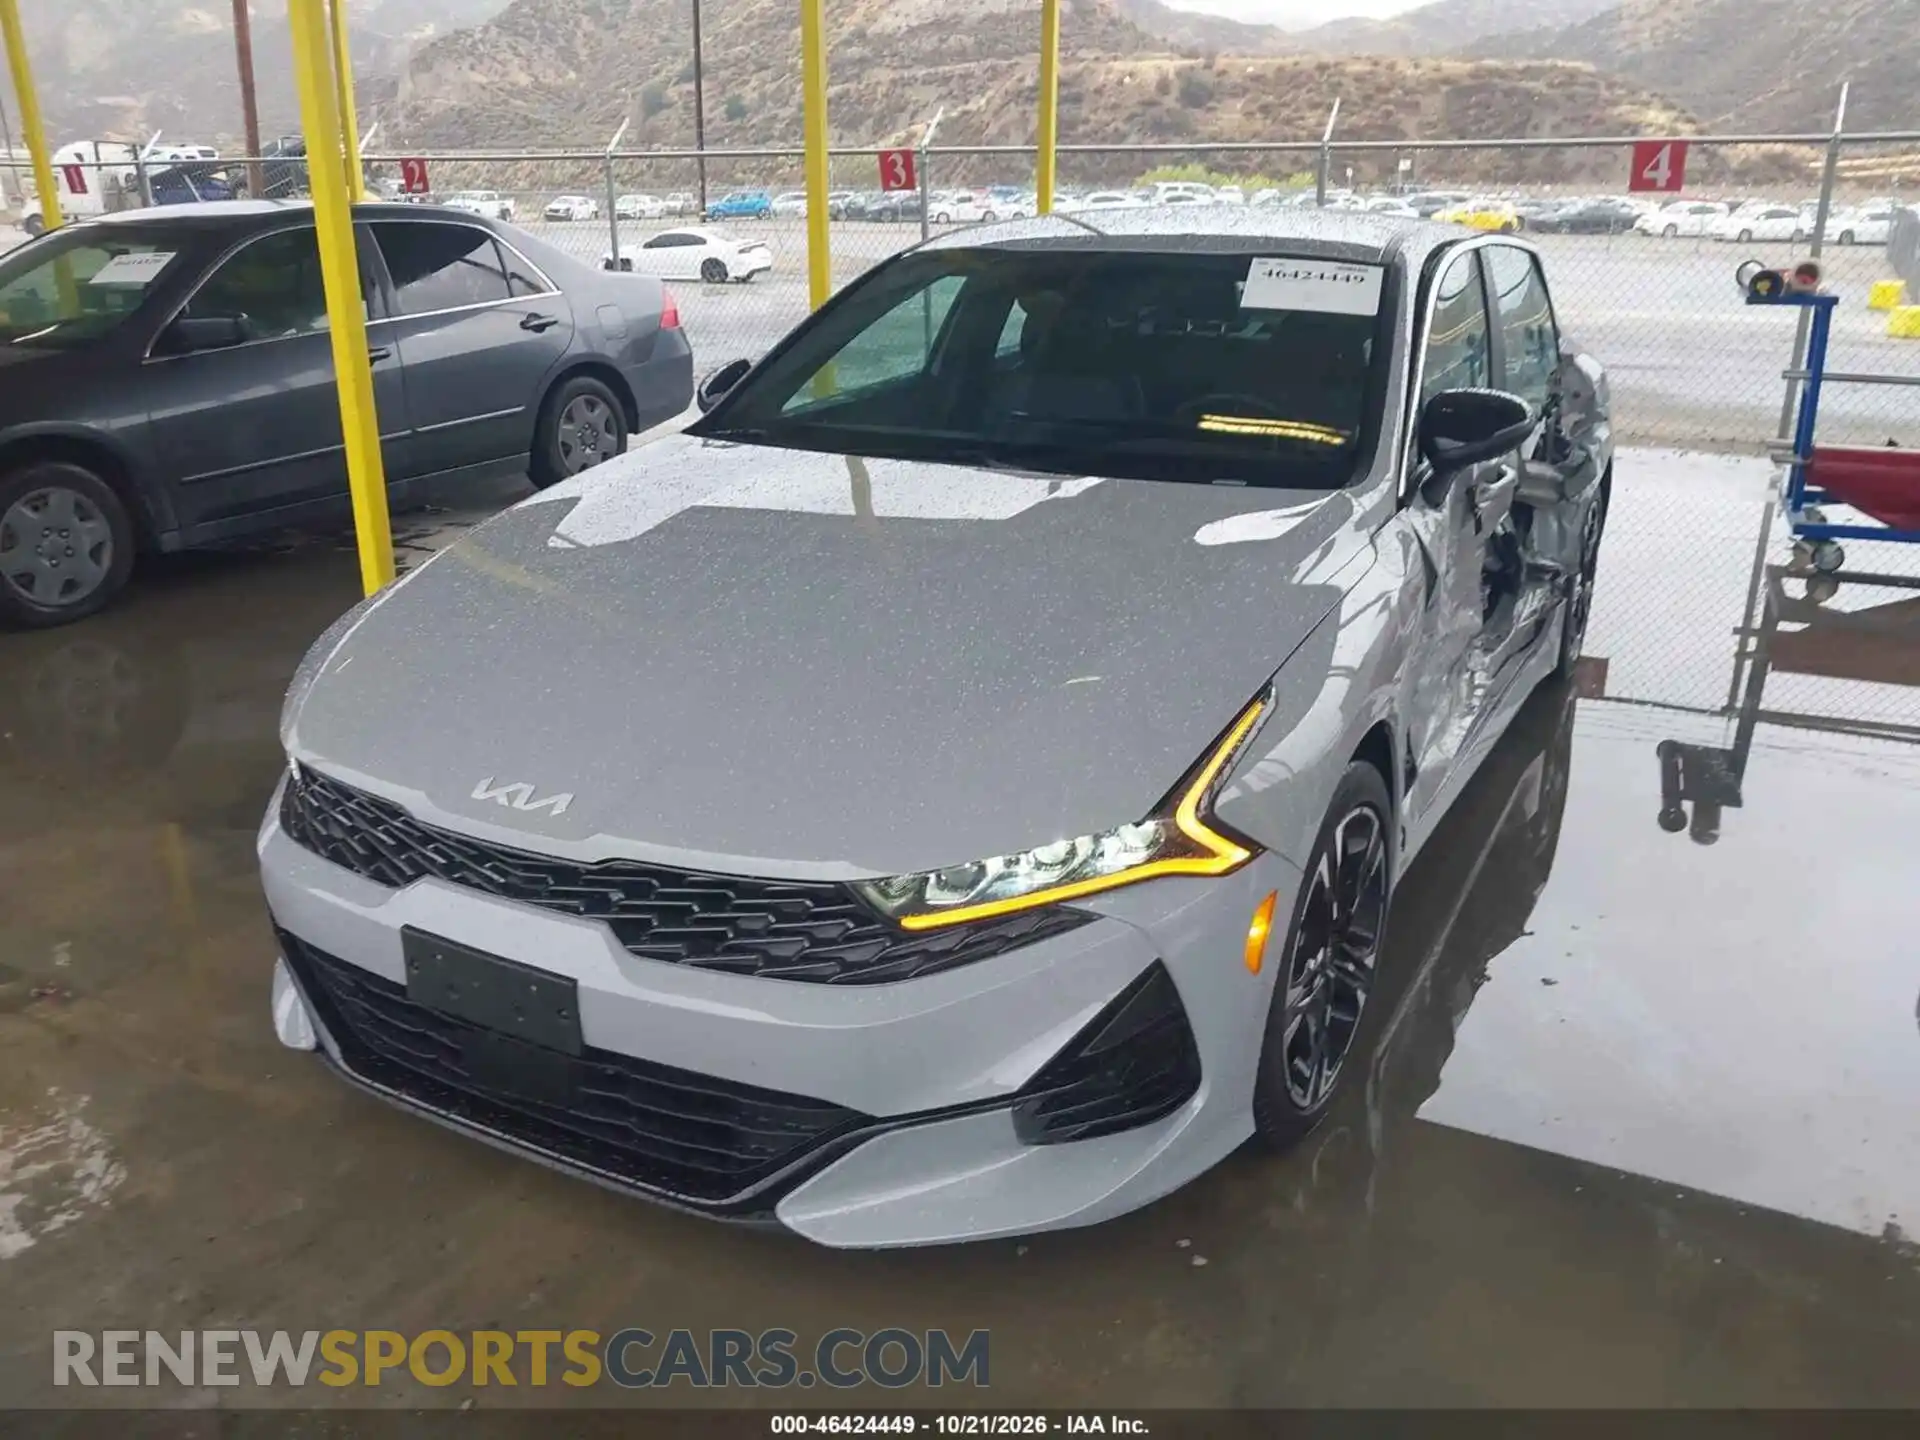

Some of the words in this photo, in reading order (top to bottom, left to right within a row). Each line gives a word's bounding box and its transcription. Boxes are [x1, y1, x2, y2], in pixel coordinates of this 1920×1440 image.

[407, 160, 423, 191] 2
[887, 152, 906, 188] 3
[1642, 142, 1672, 188] 4
[1261, 268, 1366, 284] 46424449
[471, 776, 575, 816] KIA
